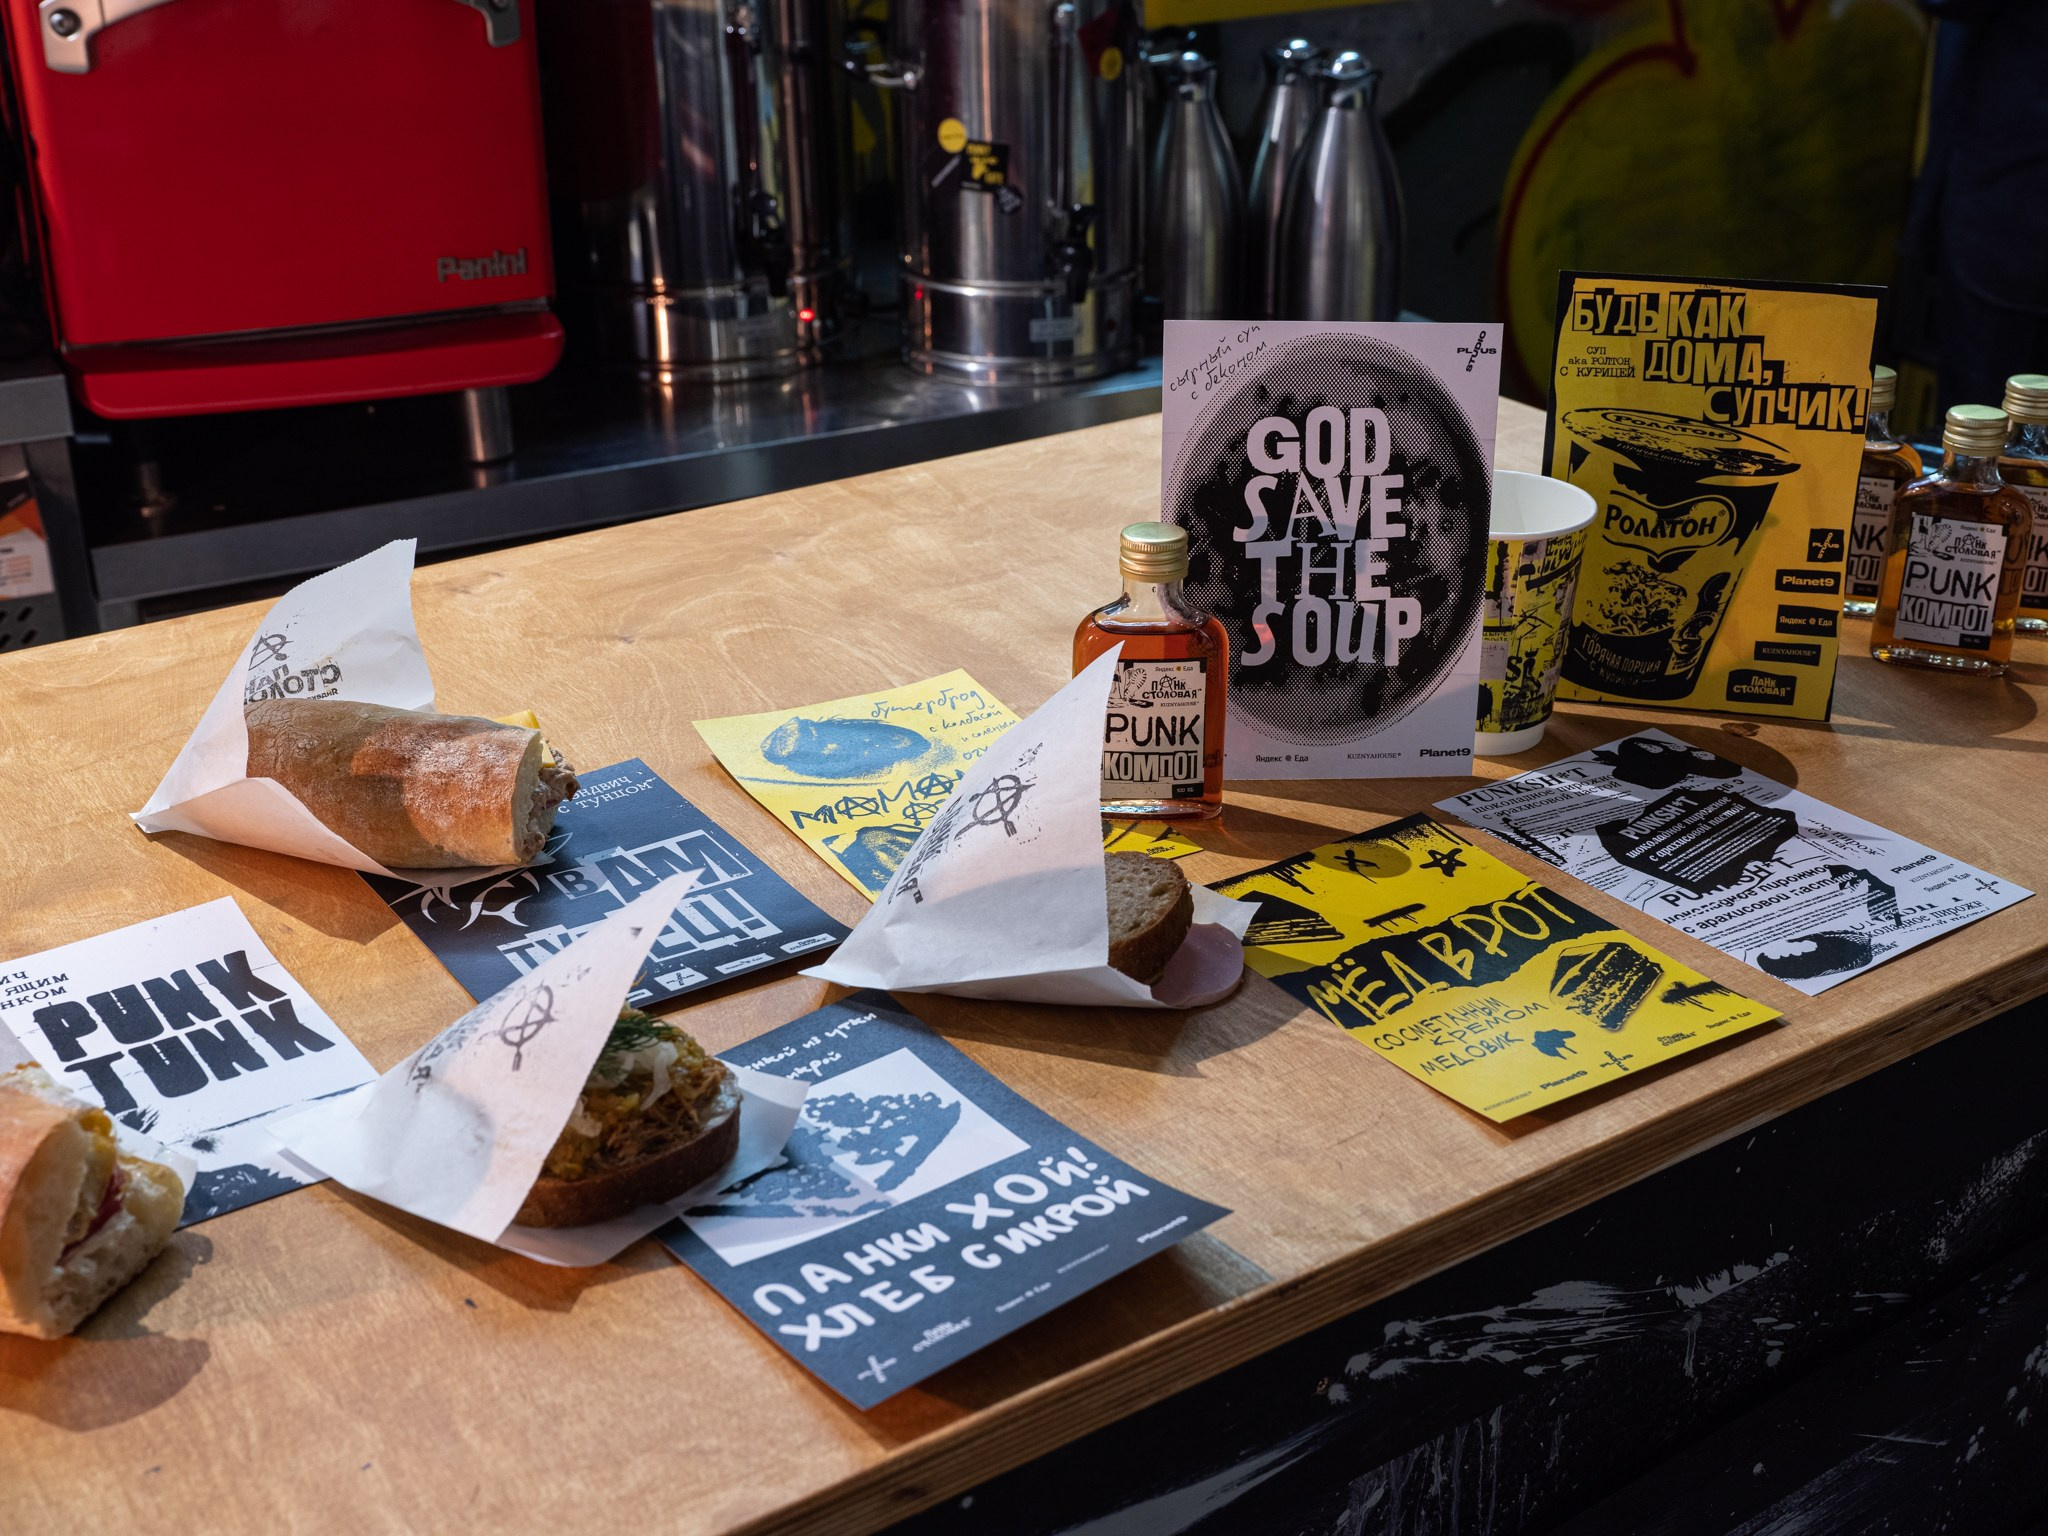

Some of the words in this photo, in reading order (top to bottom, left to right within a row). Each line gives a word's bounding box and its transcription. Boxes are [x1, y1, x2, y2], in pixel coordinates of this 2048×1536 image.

[437, 247, 528, 283] Panini
[1573, 293, 1660, 334] БУДЬ
[1667, 293, 1746, 338] КАК
[1170, 336, 1232, 392] сырный
[1237, 325, 1260, 343] суп
[1205, 341, 1268, 391] беконом
[1466, 330, 1486, 372] STUDIO
[1568, 357, 1587, 365] aka
[1586, 346, 1606, 355] СУП
[1644, 340, 1775, 386] ДОМА,
[1560, 366, 1568, 376] С
[1576, 365, 1636, 378] КУРИЦЕЙ
[1703, 385, 1868, 431] СУПЧИК!
[1246, 406, 1390, 478] GOD
[1233, 473, 1406, 543] SAVE
[1853, 523, 1888, 552] NK
[1245, 539, 1392, 602] THE
[1782, 576, 1835, 587] Planet9
[1906, 560, 1996, 601] PUNK
[1240, 597, 1422, 668] SOUP
[1780, 616, 1806, 626] Яндекс
[1818, 617, 1833, 626] Еда
[1900, 595, 1988, 632] КОМПОТ
[871, 688, 986, 718] бутерброд
[942, 704, 1002, 730] колбасой
[1106, 712, 1200, 747] PUNK
[1104, 752, 1198, 782] КОМПОТ
[1255, 754, 1282, 763] Яндекс
[1294, 754, 1309, 762] Еда
[1419, 748, 1471, 758] Planet9
[1472, 788, 1552, 814] шоколадное
[1556, 774, 1614, 797] пирожно
[1626, 822, 1687, 859] шоколадное
[1685, 796, 1732, 826] пирожное
[1658, 822, 1710, 860] арахисовой
[1710, 803, 1746, 829] пастой
[1760, 864, 1832, 892] пирожно
[1890, 854, 1938, 874] Planet9
[33, 950, 288, 1063] PUNK
[825, 1012, 877, 1038] утки
[1430, 1002, 1550, 1046] КРЕМОМ
[64, 998, 336, 1116] TUNK
[1420, 1032, 1524, 1076] МЕДОВИК
[1539, 1070, 1588, 1090] Planet9
[753, 1221, 951, 1316] ПАНКИ
[944, 1146, 1098, 1230] ХОЙ!
[778, 1264, 956, 1352] ХЛЕБ
